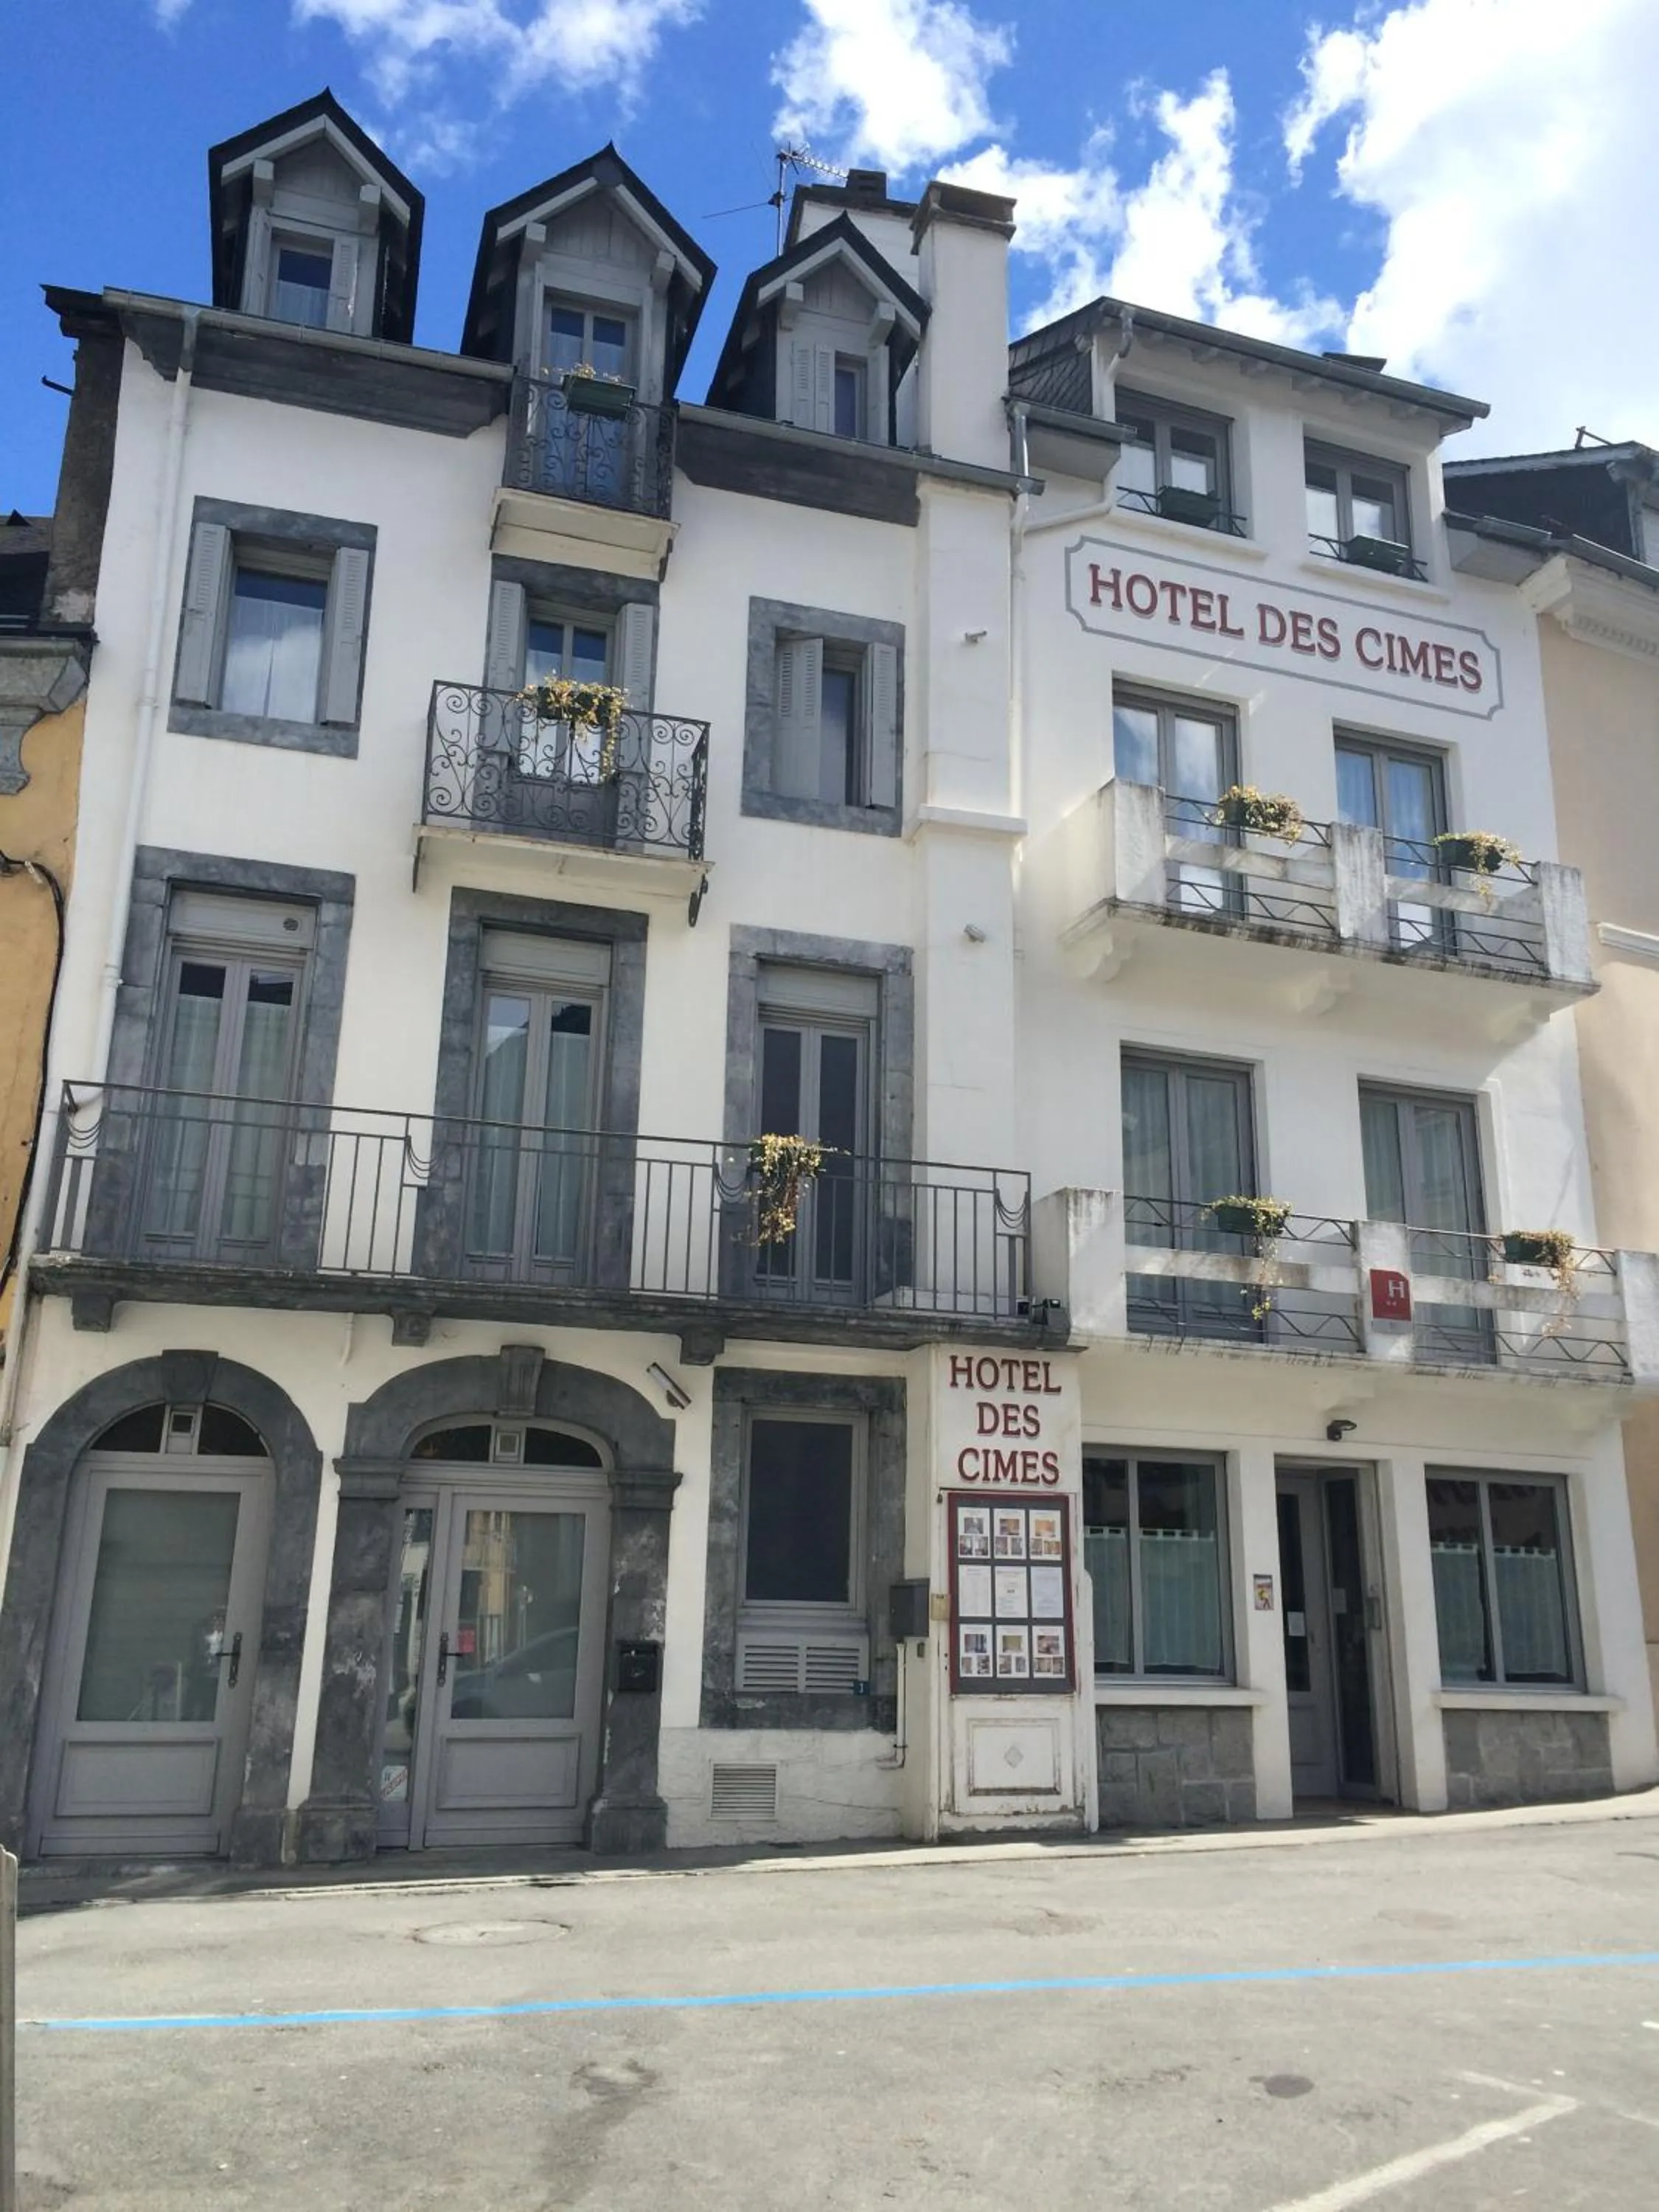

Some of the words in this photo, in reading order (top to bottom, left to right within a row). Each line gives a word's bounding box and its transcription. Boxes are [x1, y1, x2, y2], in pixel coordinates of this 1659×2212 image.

[1088, 563, 1245, 638] HOTEL
[1256, 602, 1342, 661] DES
[1354, 627, 1484, 692] CIMES
[1388, 1279, 1405, 1298] H
[949, 1354, 1062, 1394] HOTEL
[976, 1402, 1041, 1438] DES
[957, 1447, 1060, 1486] CIMES
